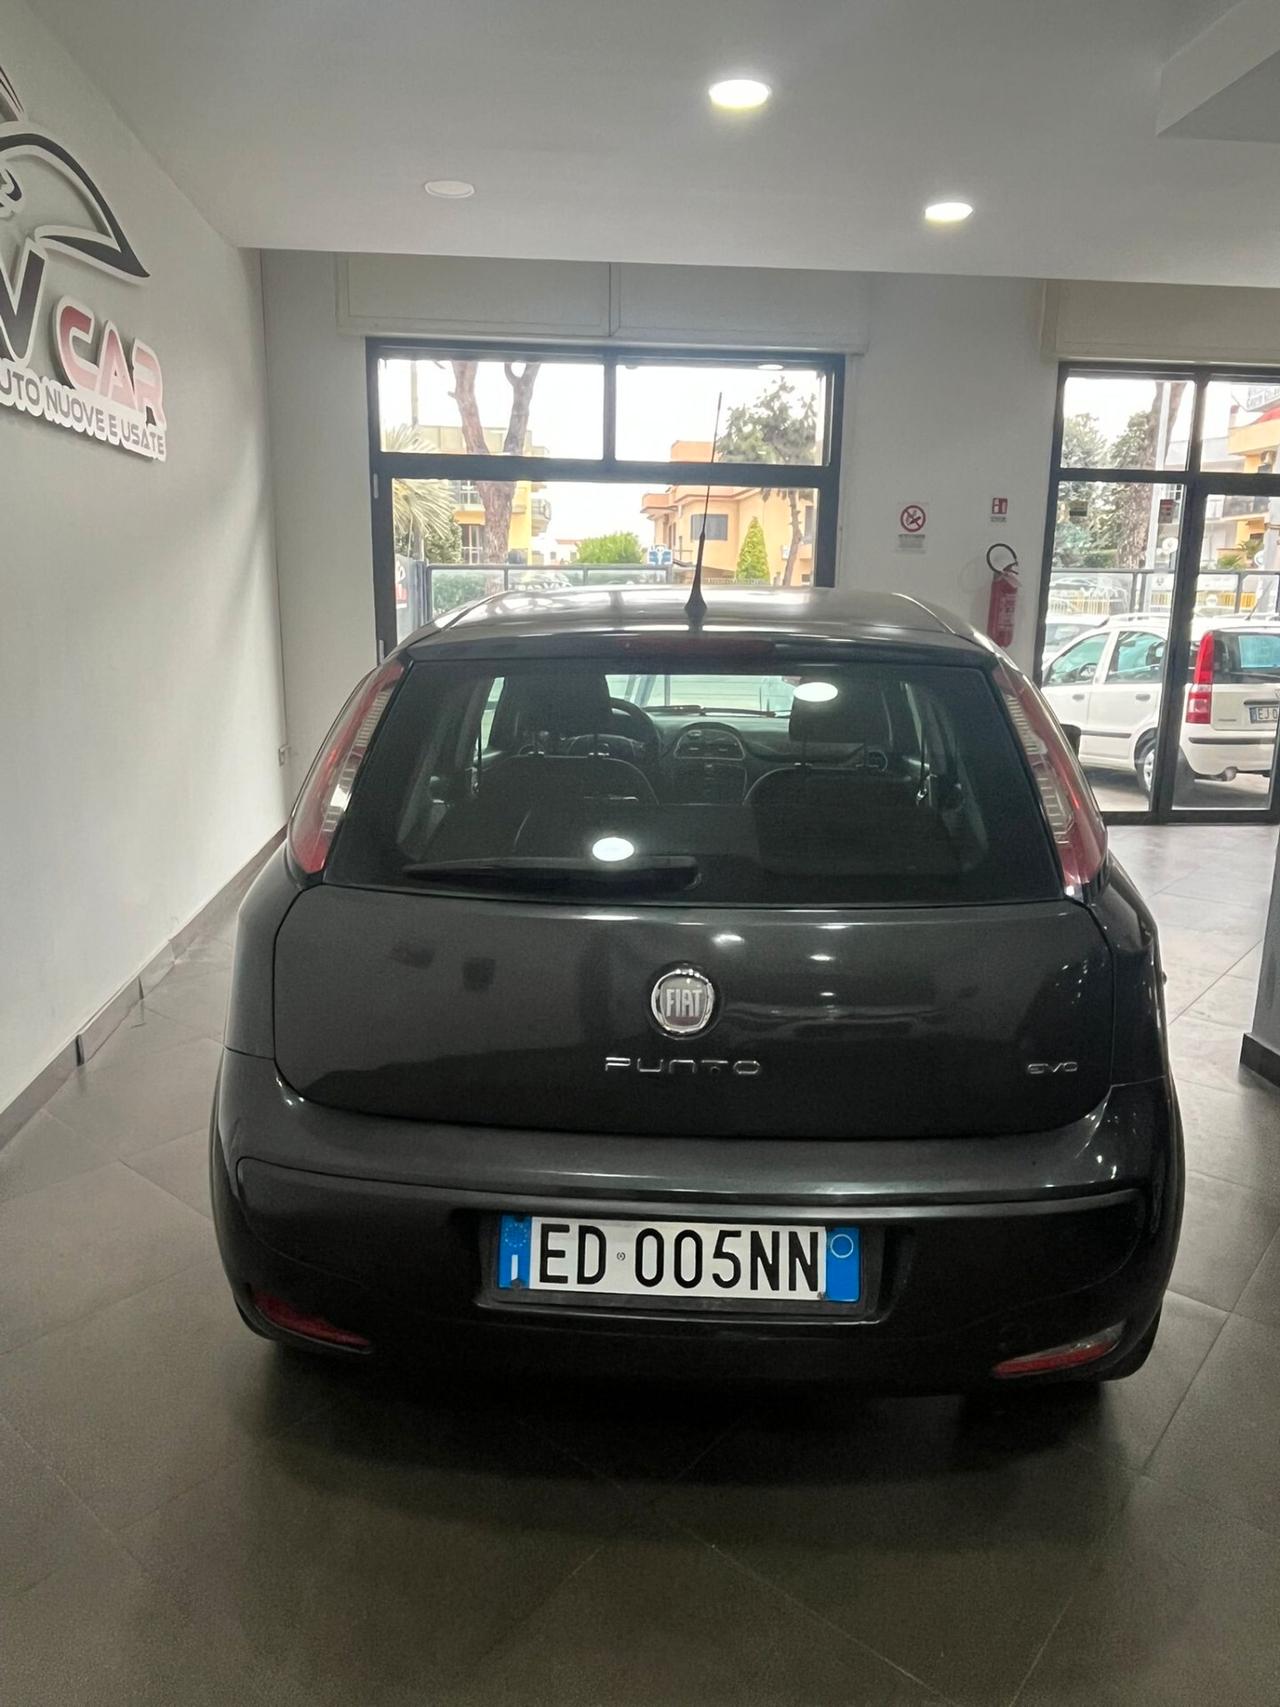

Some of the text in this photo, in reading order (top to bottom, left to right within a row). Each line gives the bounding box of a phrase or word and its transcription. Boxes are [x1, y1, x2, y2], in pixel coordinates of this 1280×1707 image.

[59, 304, 165, 428] CAR
[46, 384, 105, 432] NUOVE
[108, 414, 119, 437] E
[121, 420, 165, 456] USATE
[666, 988, 703, 1018] FIAT
[605, 1056, 761, 1075] PUNTO
[1027, 1061, 1078, 1075] EVO
[539, 1223, 607, 1285] ED
[635, 1227, 819, 1292] 005NN
